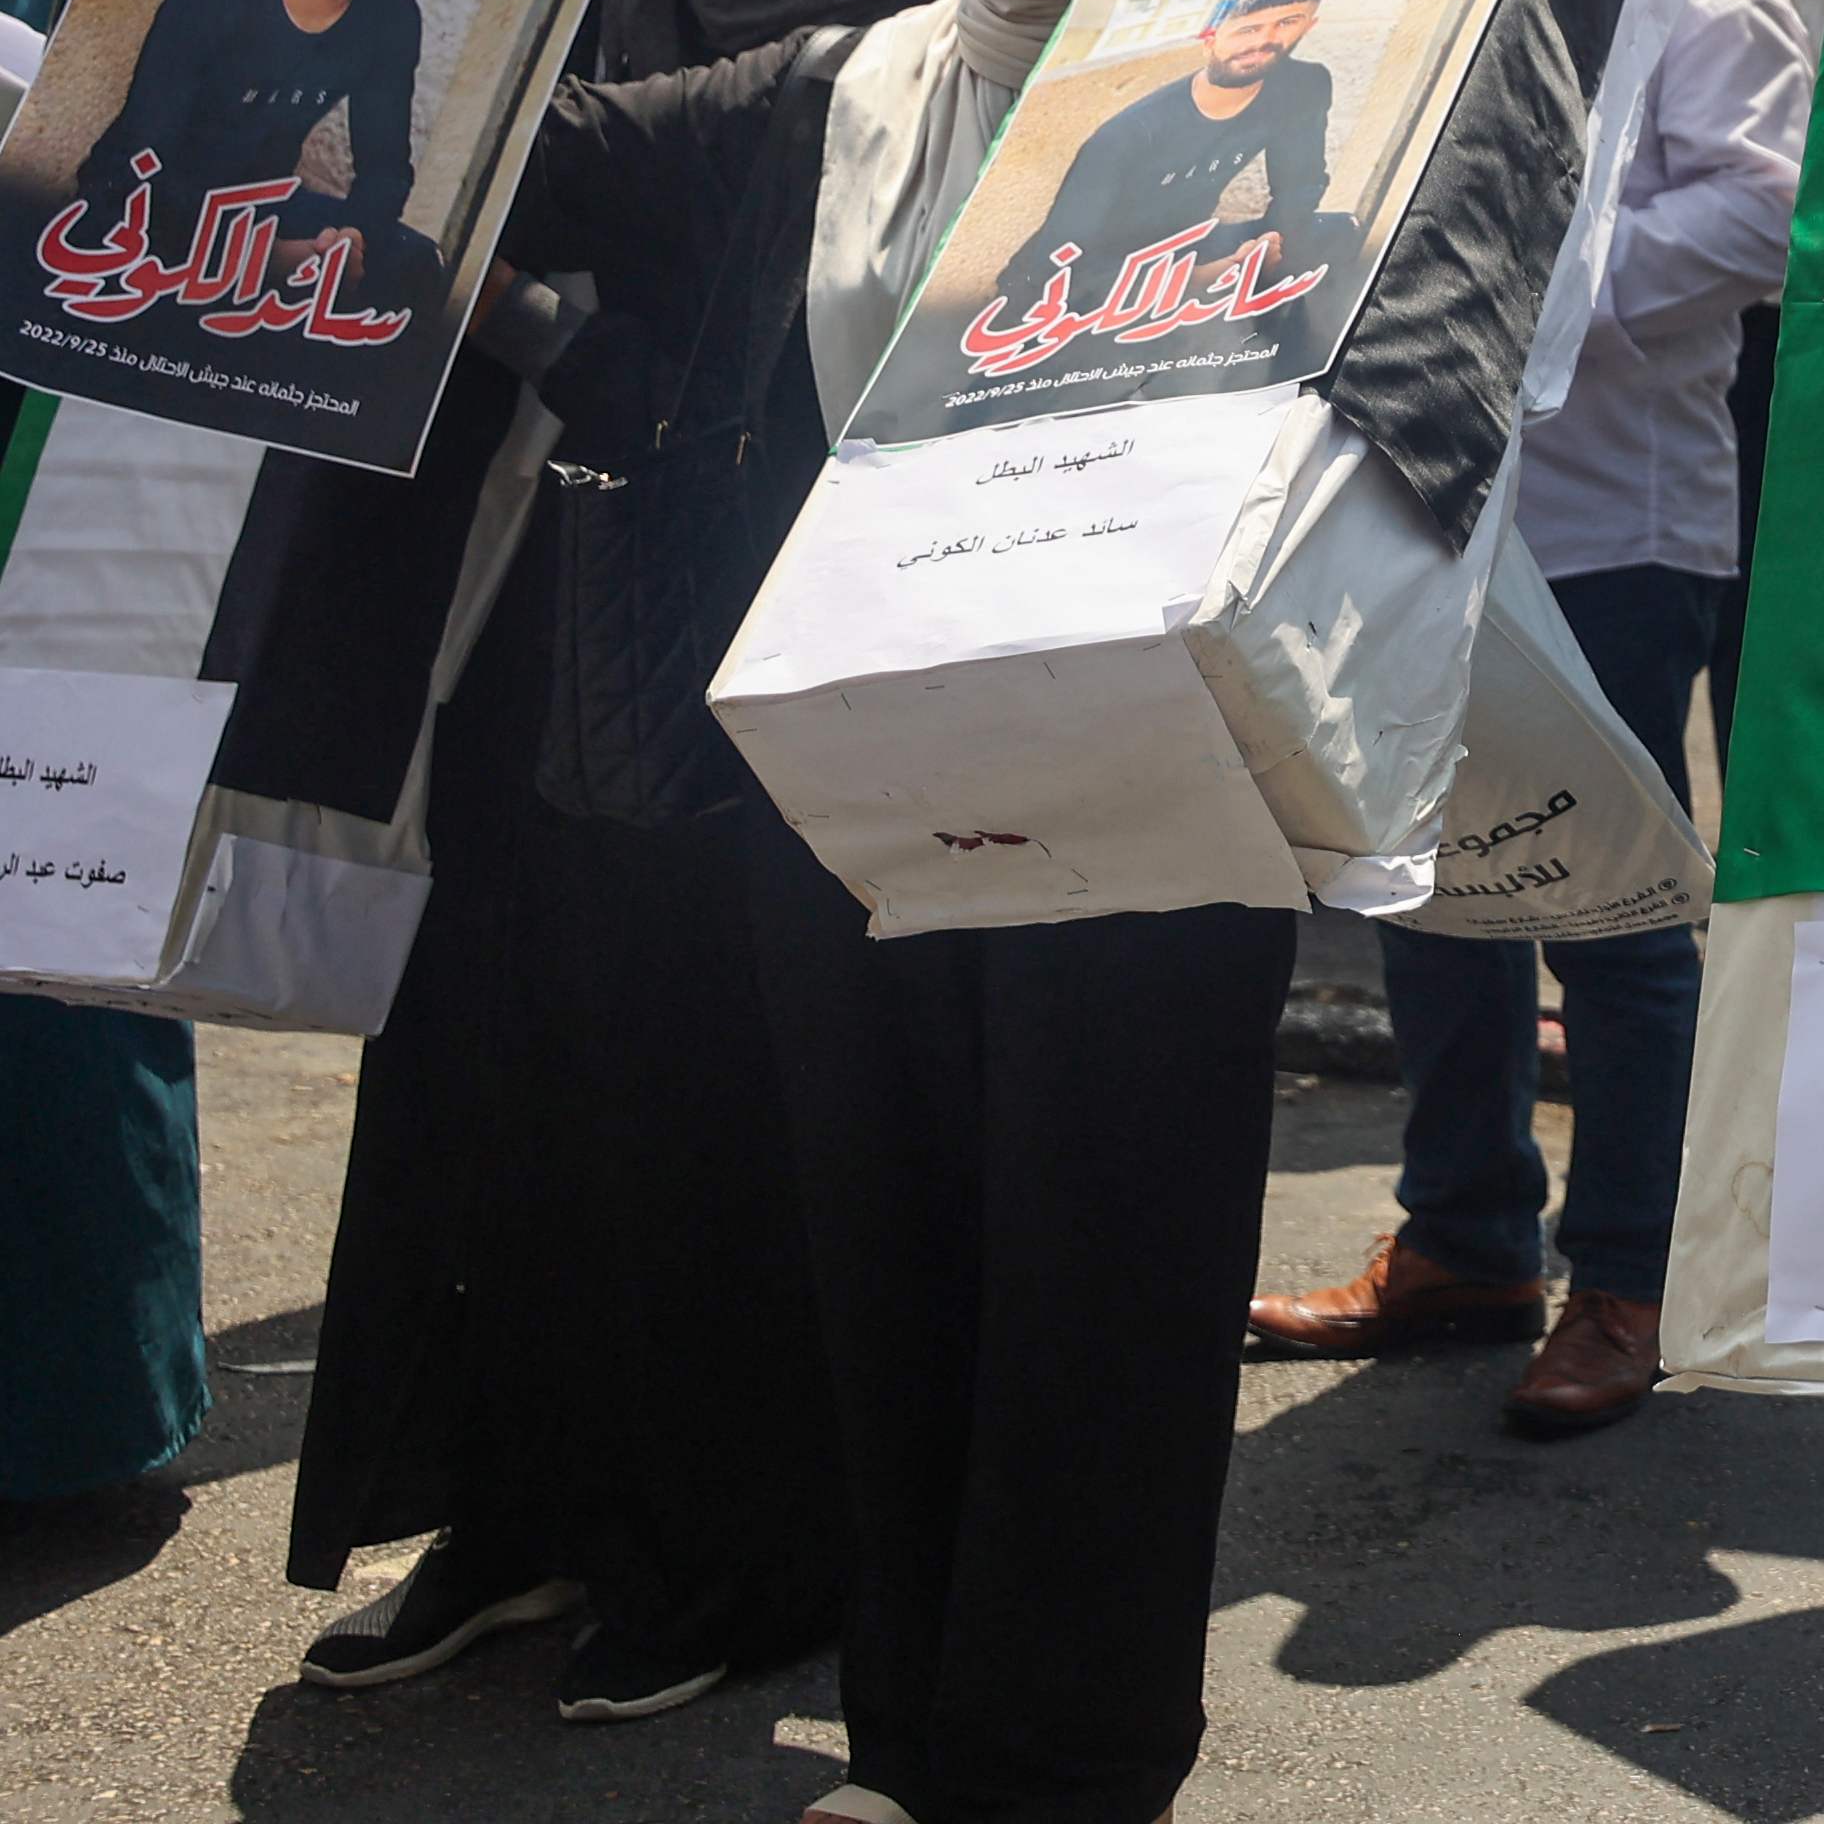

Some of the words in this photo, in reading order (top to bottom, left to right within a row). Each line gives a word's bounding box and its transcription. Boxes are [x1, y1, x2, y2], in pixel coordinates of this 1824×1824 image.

[37, 146, 302, 323] الكوني
[200, 237, 413, 347] سائد
[960, 217, 1220, 377] الكوني
[1114, 239, 1330, 345] سائد
[19, 320, 109, 358] 2022/9/25
[109, 344, 139, 367] منذ
[1147, 359, 1172, 374] عند
[1224, 343, 1280, 368] المحتجز
[188, 363, 230, 389] جيش
[231, 373, 257, 393] عند
[1025, 378, 1052, 392] منذ
[1102, 363, 1145, 381] جيش
[303, 388, 361, 418] المحتجز
[945, 383, 1024, 409] 2022/9/25
[976, 456, 1044, 486] البطل
[1054, 439, 1135, 473] الشهيد
[991, 526, 1068, 555] عدنان
[1082, 517, 1139, 537] سائد
[896, 535, 985, 569] الكوني
[0, 757, 36, 792] البط
[39, 760, 98, 793] الشهيد
[1437, 789, 1578, 860] مجموع
[26, 860, 57, 886] عبد
[65, 858, 127, 889] صفوت
